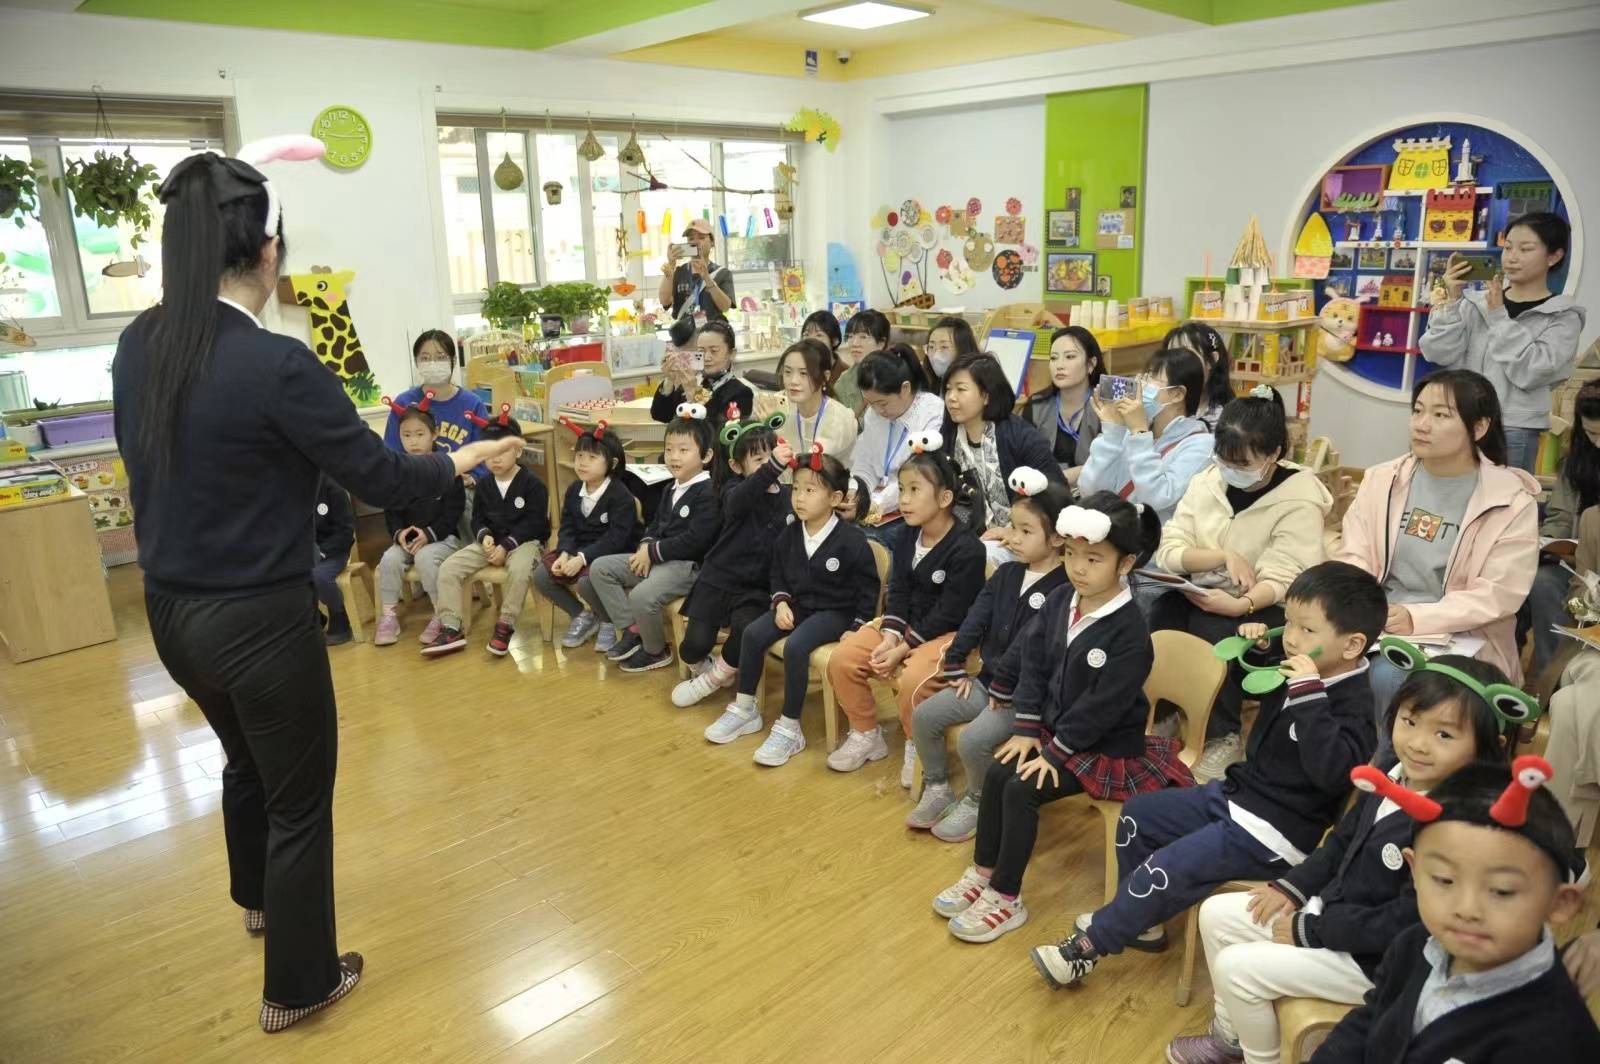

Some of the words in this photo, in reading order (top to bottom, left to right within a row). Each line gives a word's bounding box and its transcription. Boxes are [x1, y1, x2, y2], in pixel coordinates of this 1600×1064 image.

[328, 112, 336, 120] 11
[337, 111, 349, 119] 12
[320, 120, 331, 128] 10
[340, 154, 348, 162] 6
